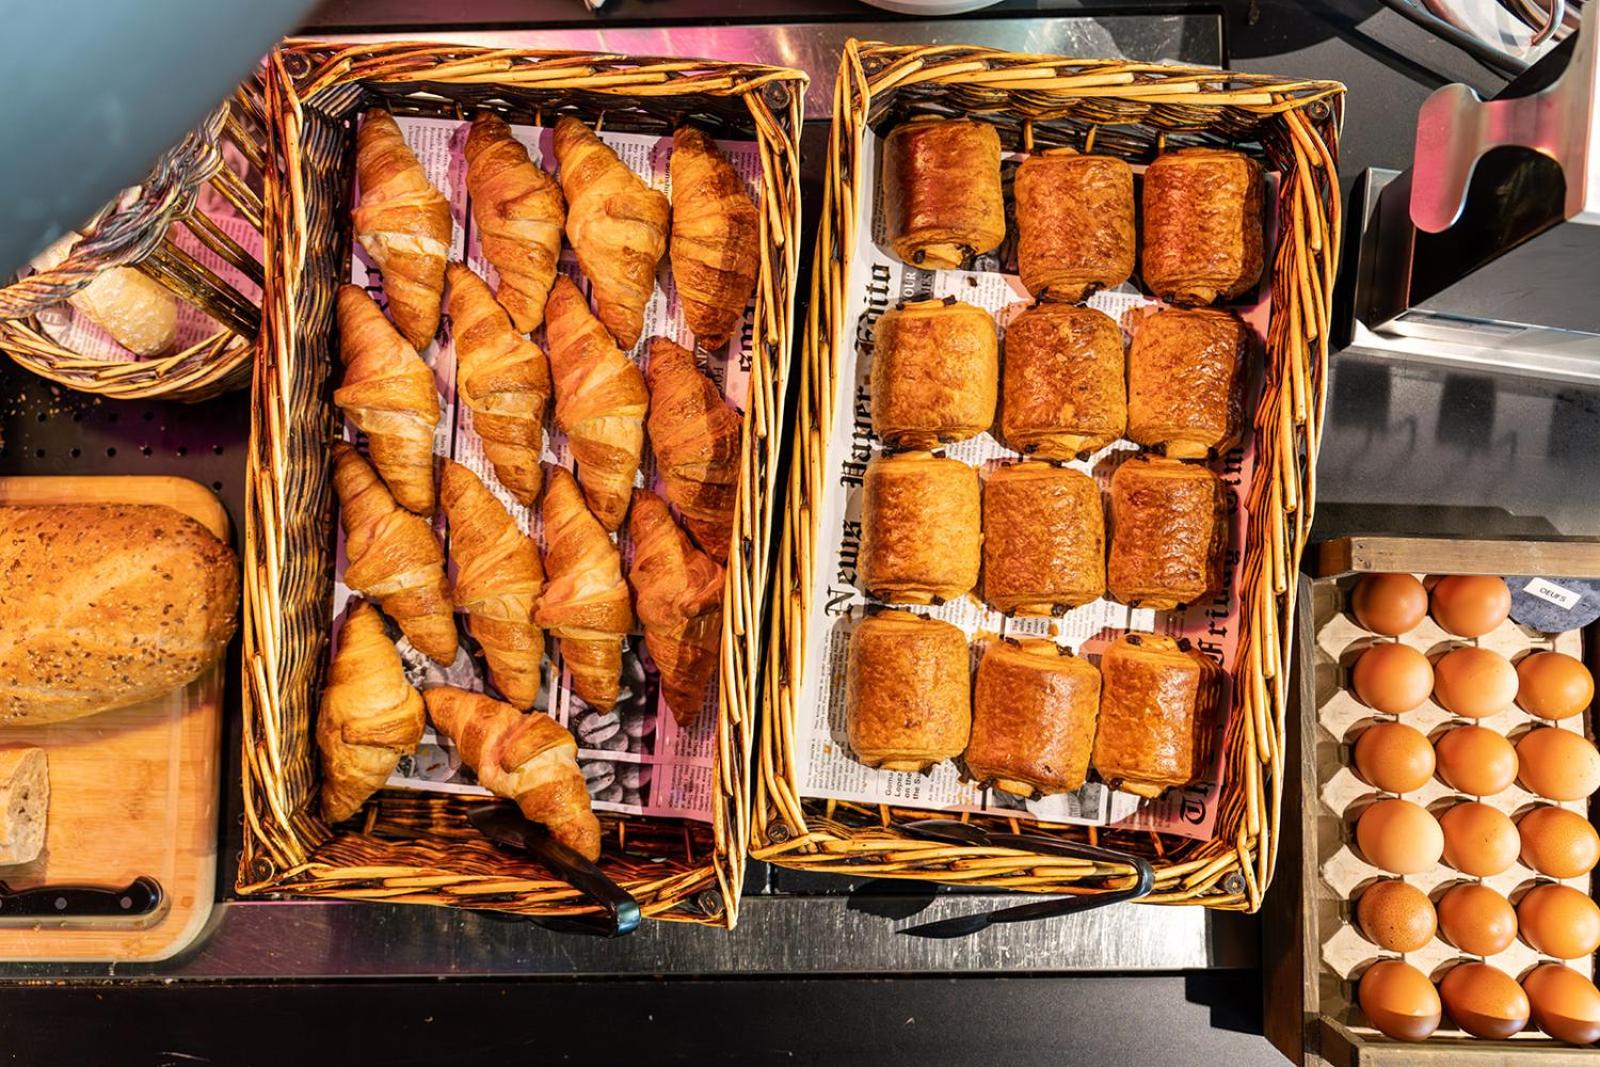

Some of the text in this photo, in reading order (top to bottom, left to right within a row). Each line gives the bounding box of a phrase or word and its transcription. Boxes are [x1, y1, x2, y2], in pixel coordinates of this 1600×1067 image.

[902, 271, 917, 299] OUR
[840, 386, 880, 489] Paper
[823, 520, 862, 618] News
[1539, 587, 1567, 602] OEUFS
[894, 773, 904, 797] Lopez
[904, 771, 913, 799] on the
[912, 786, 921, 800] the
